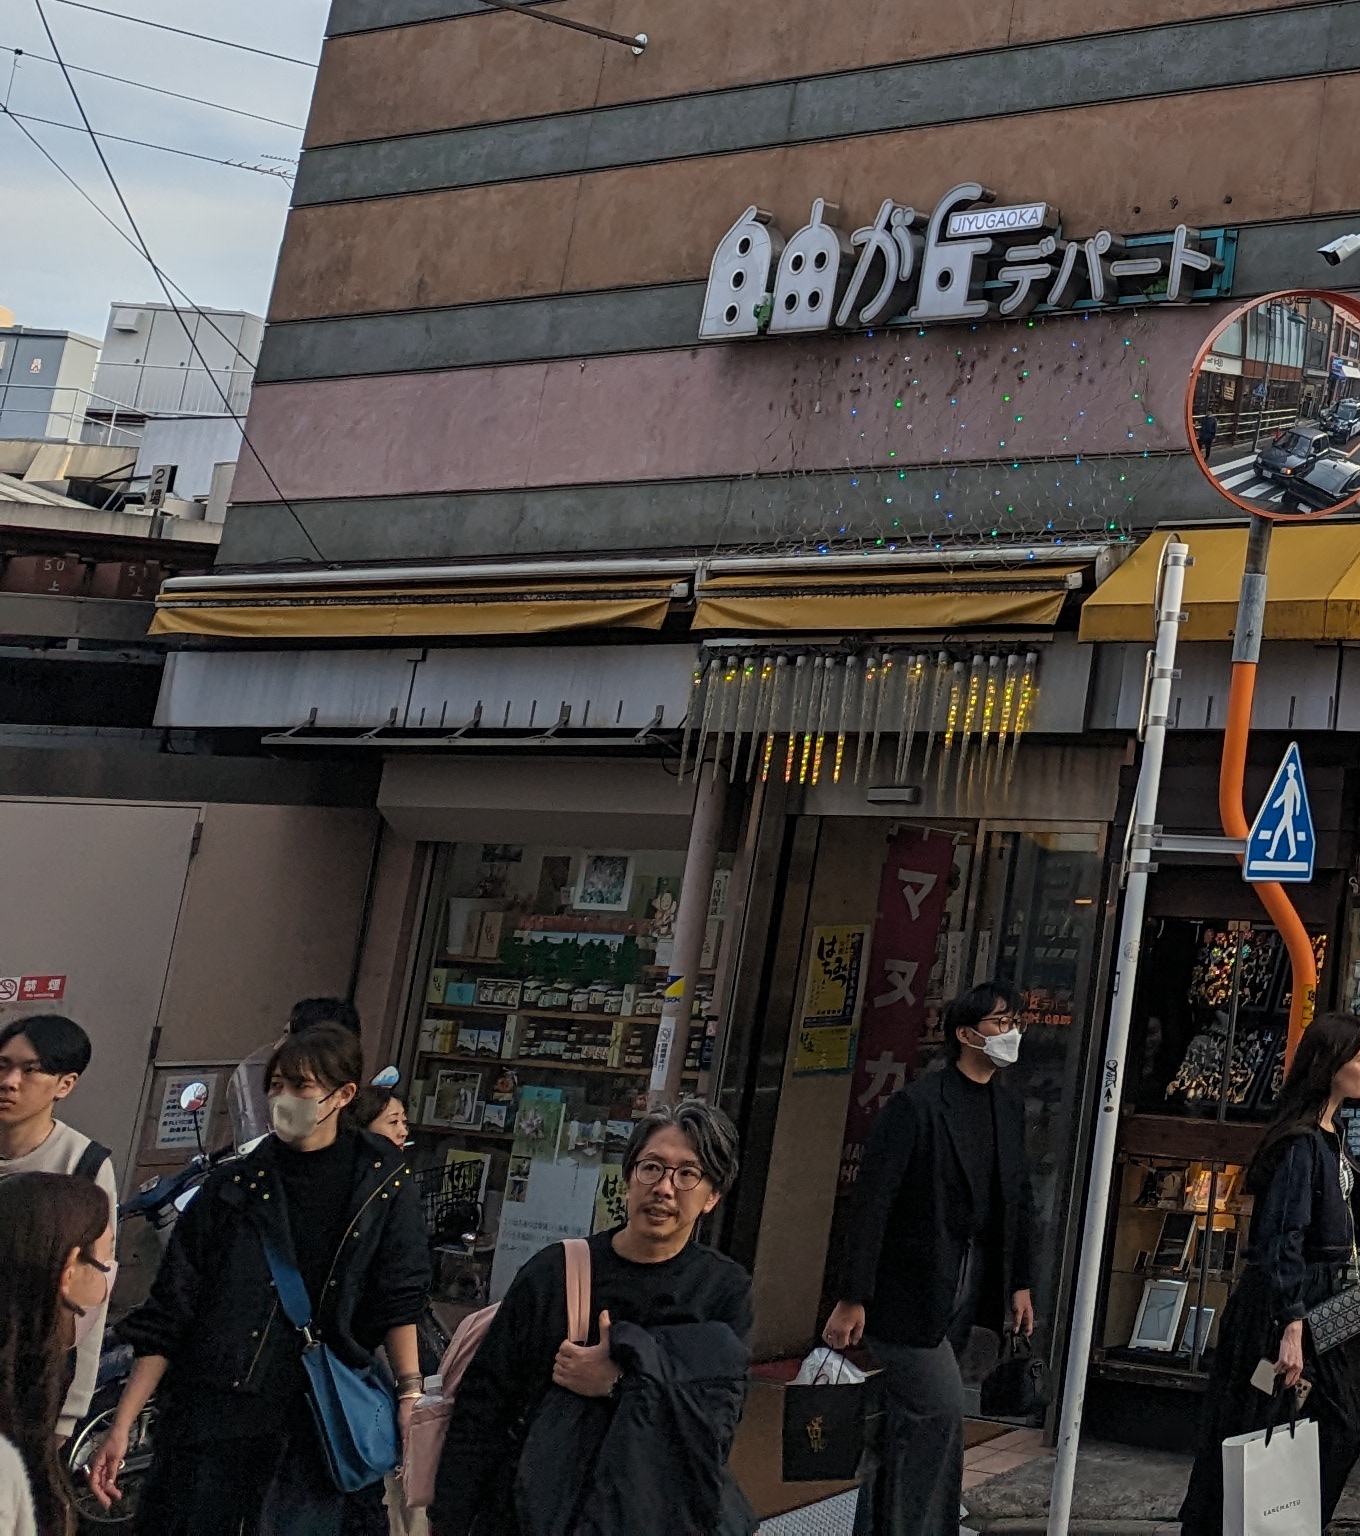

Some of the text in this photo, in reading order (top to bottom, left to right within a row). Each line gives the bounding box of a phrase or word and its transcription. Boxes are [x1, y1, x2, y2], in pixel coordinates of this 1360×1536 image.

[951, 208, 1040, 234] JIYUGAOKA
[817, 935, 848, 988] はちみつ
[23, 978, 62, 992] 禁煙
[857, 867, 938, 1108] マヌカ
